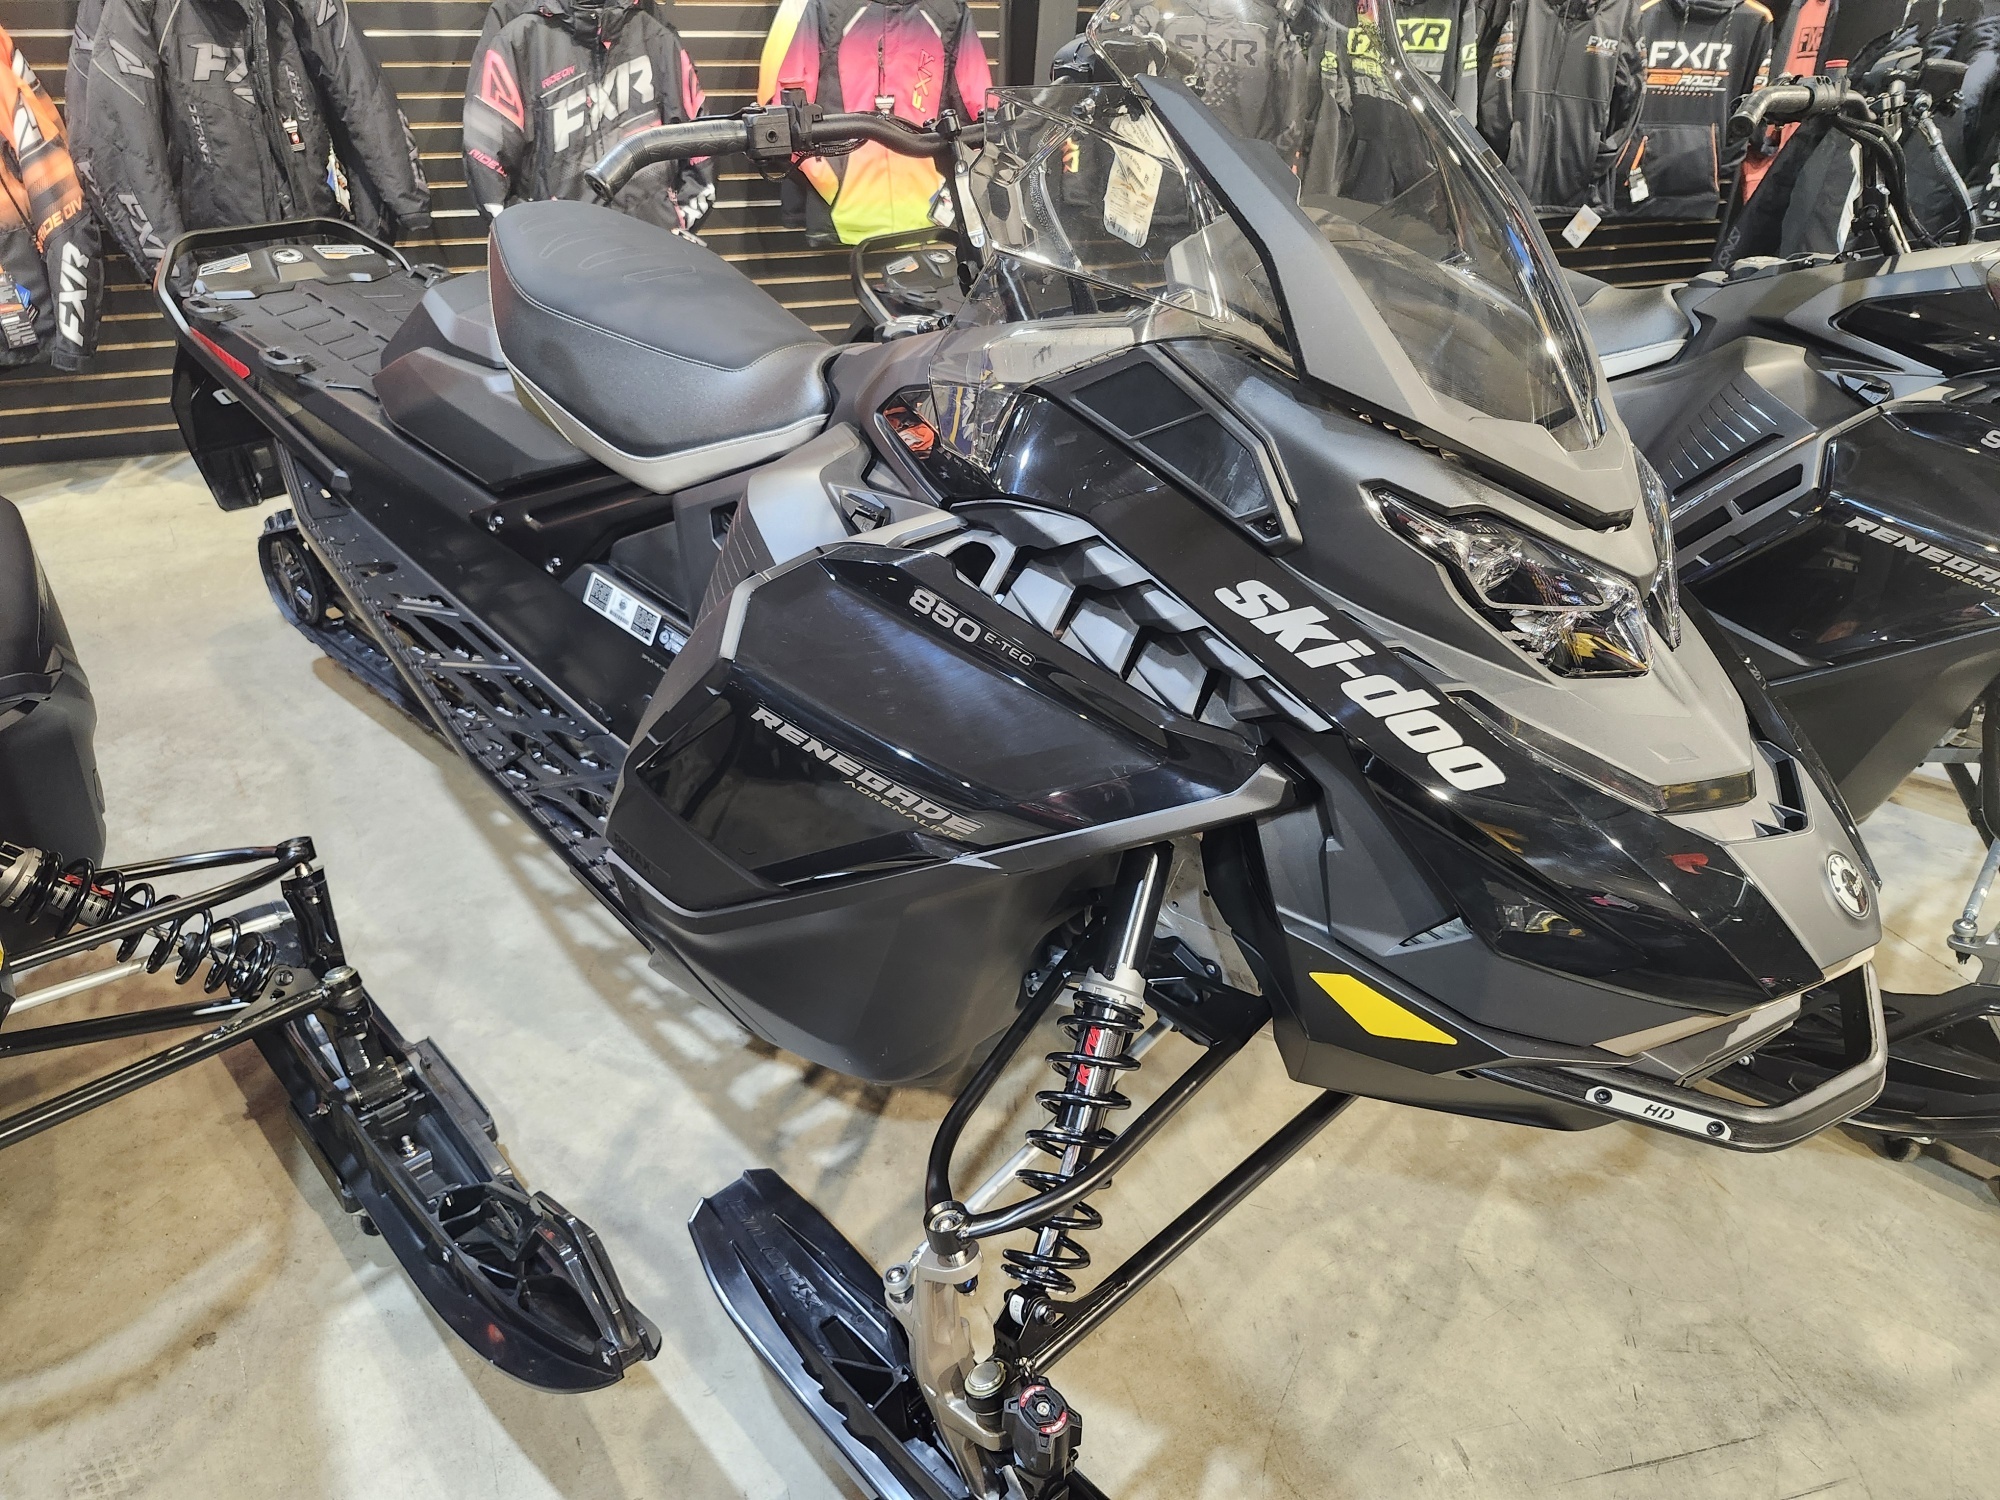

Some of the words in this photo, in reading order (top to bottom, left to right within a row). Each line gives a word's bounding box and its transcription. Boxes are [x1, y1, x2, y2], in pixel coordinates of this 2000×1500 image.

[1174, 34, 1258, 67] FXR
[1588, 35, 1619, 50] FXR
[1648, 41, 1733, 70] FXR
[546, 54, 655, 153] FXR
[912, 49, 935, 113] FXR
[59, 241, 90, 347] FXR
[909, 588, 981, 643] 850
[983, 632, 1033, 666] E-TEC
[750, 706, 983, 836] RENEGADE
[843, 780, 965, 841] ADRENALINE
[1643, 1104, 1675, 1120] HD
